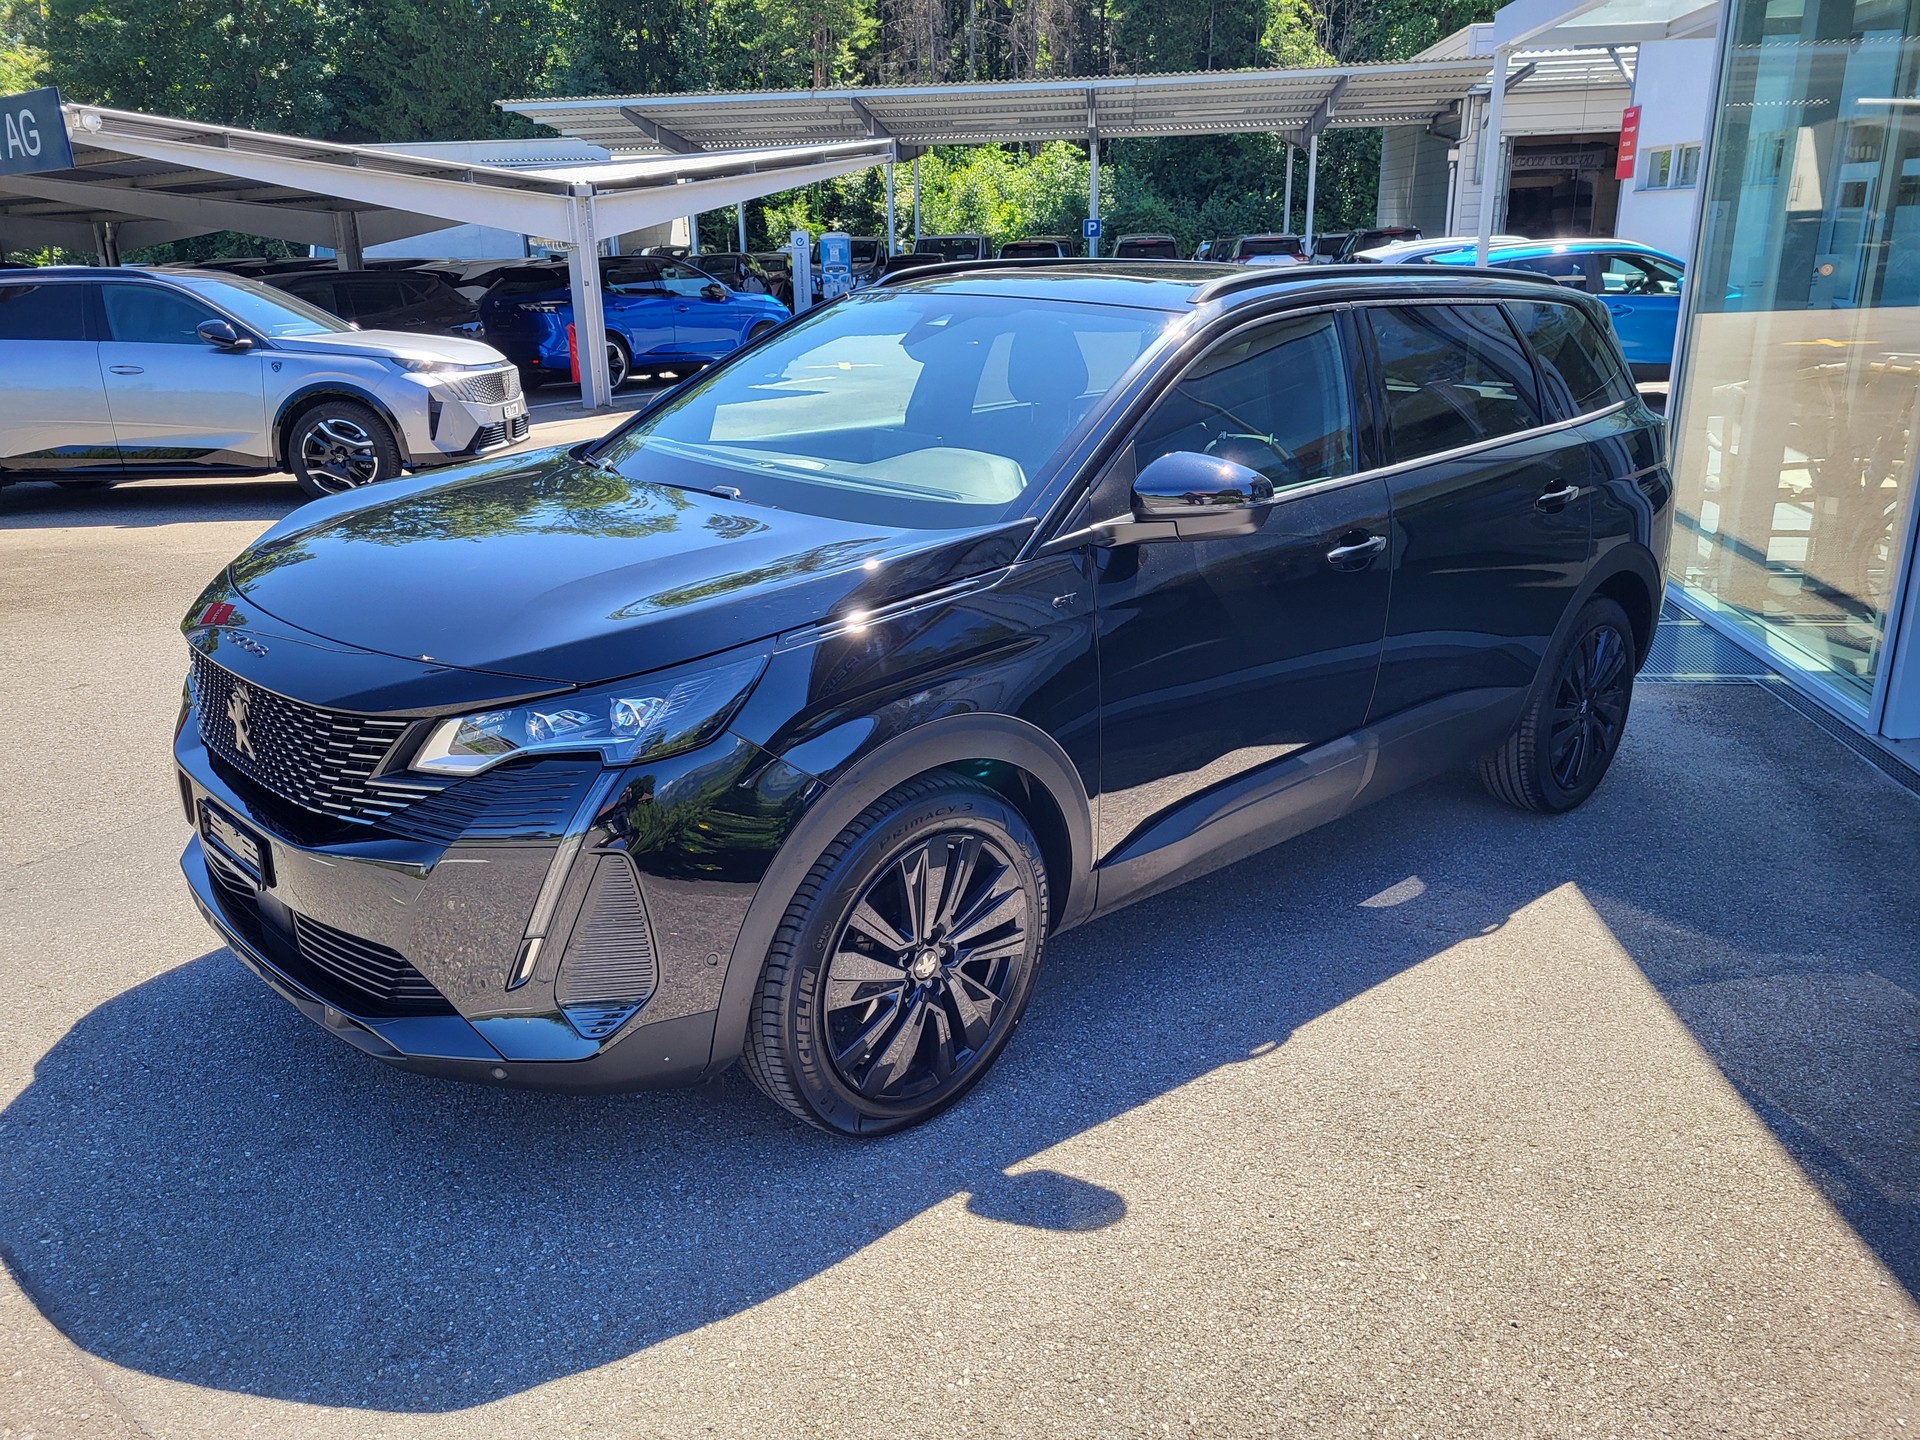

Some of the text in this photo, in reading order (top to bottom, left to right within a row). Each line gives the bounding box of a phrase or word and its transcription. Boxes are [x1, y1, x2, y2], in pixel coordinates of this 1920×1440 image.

[5, 109, 41, 158] AG
[1088, 222, 1097, 235] P
[226, 630, 270, 658] 5008
[879, 805, 957, 850] PRIMACY
[796, 968, 823, 1090] MICHELIN
